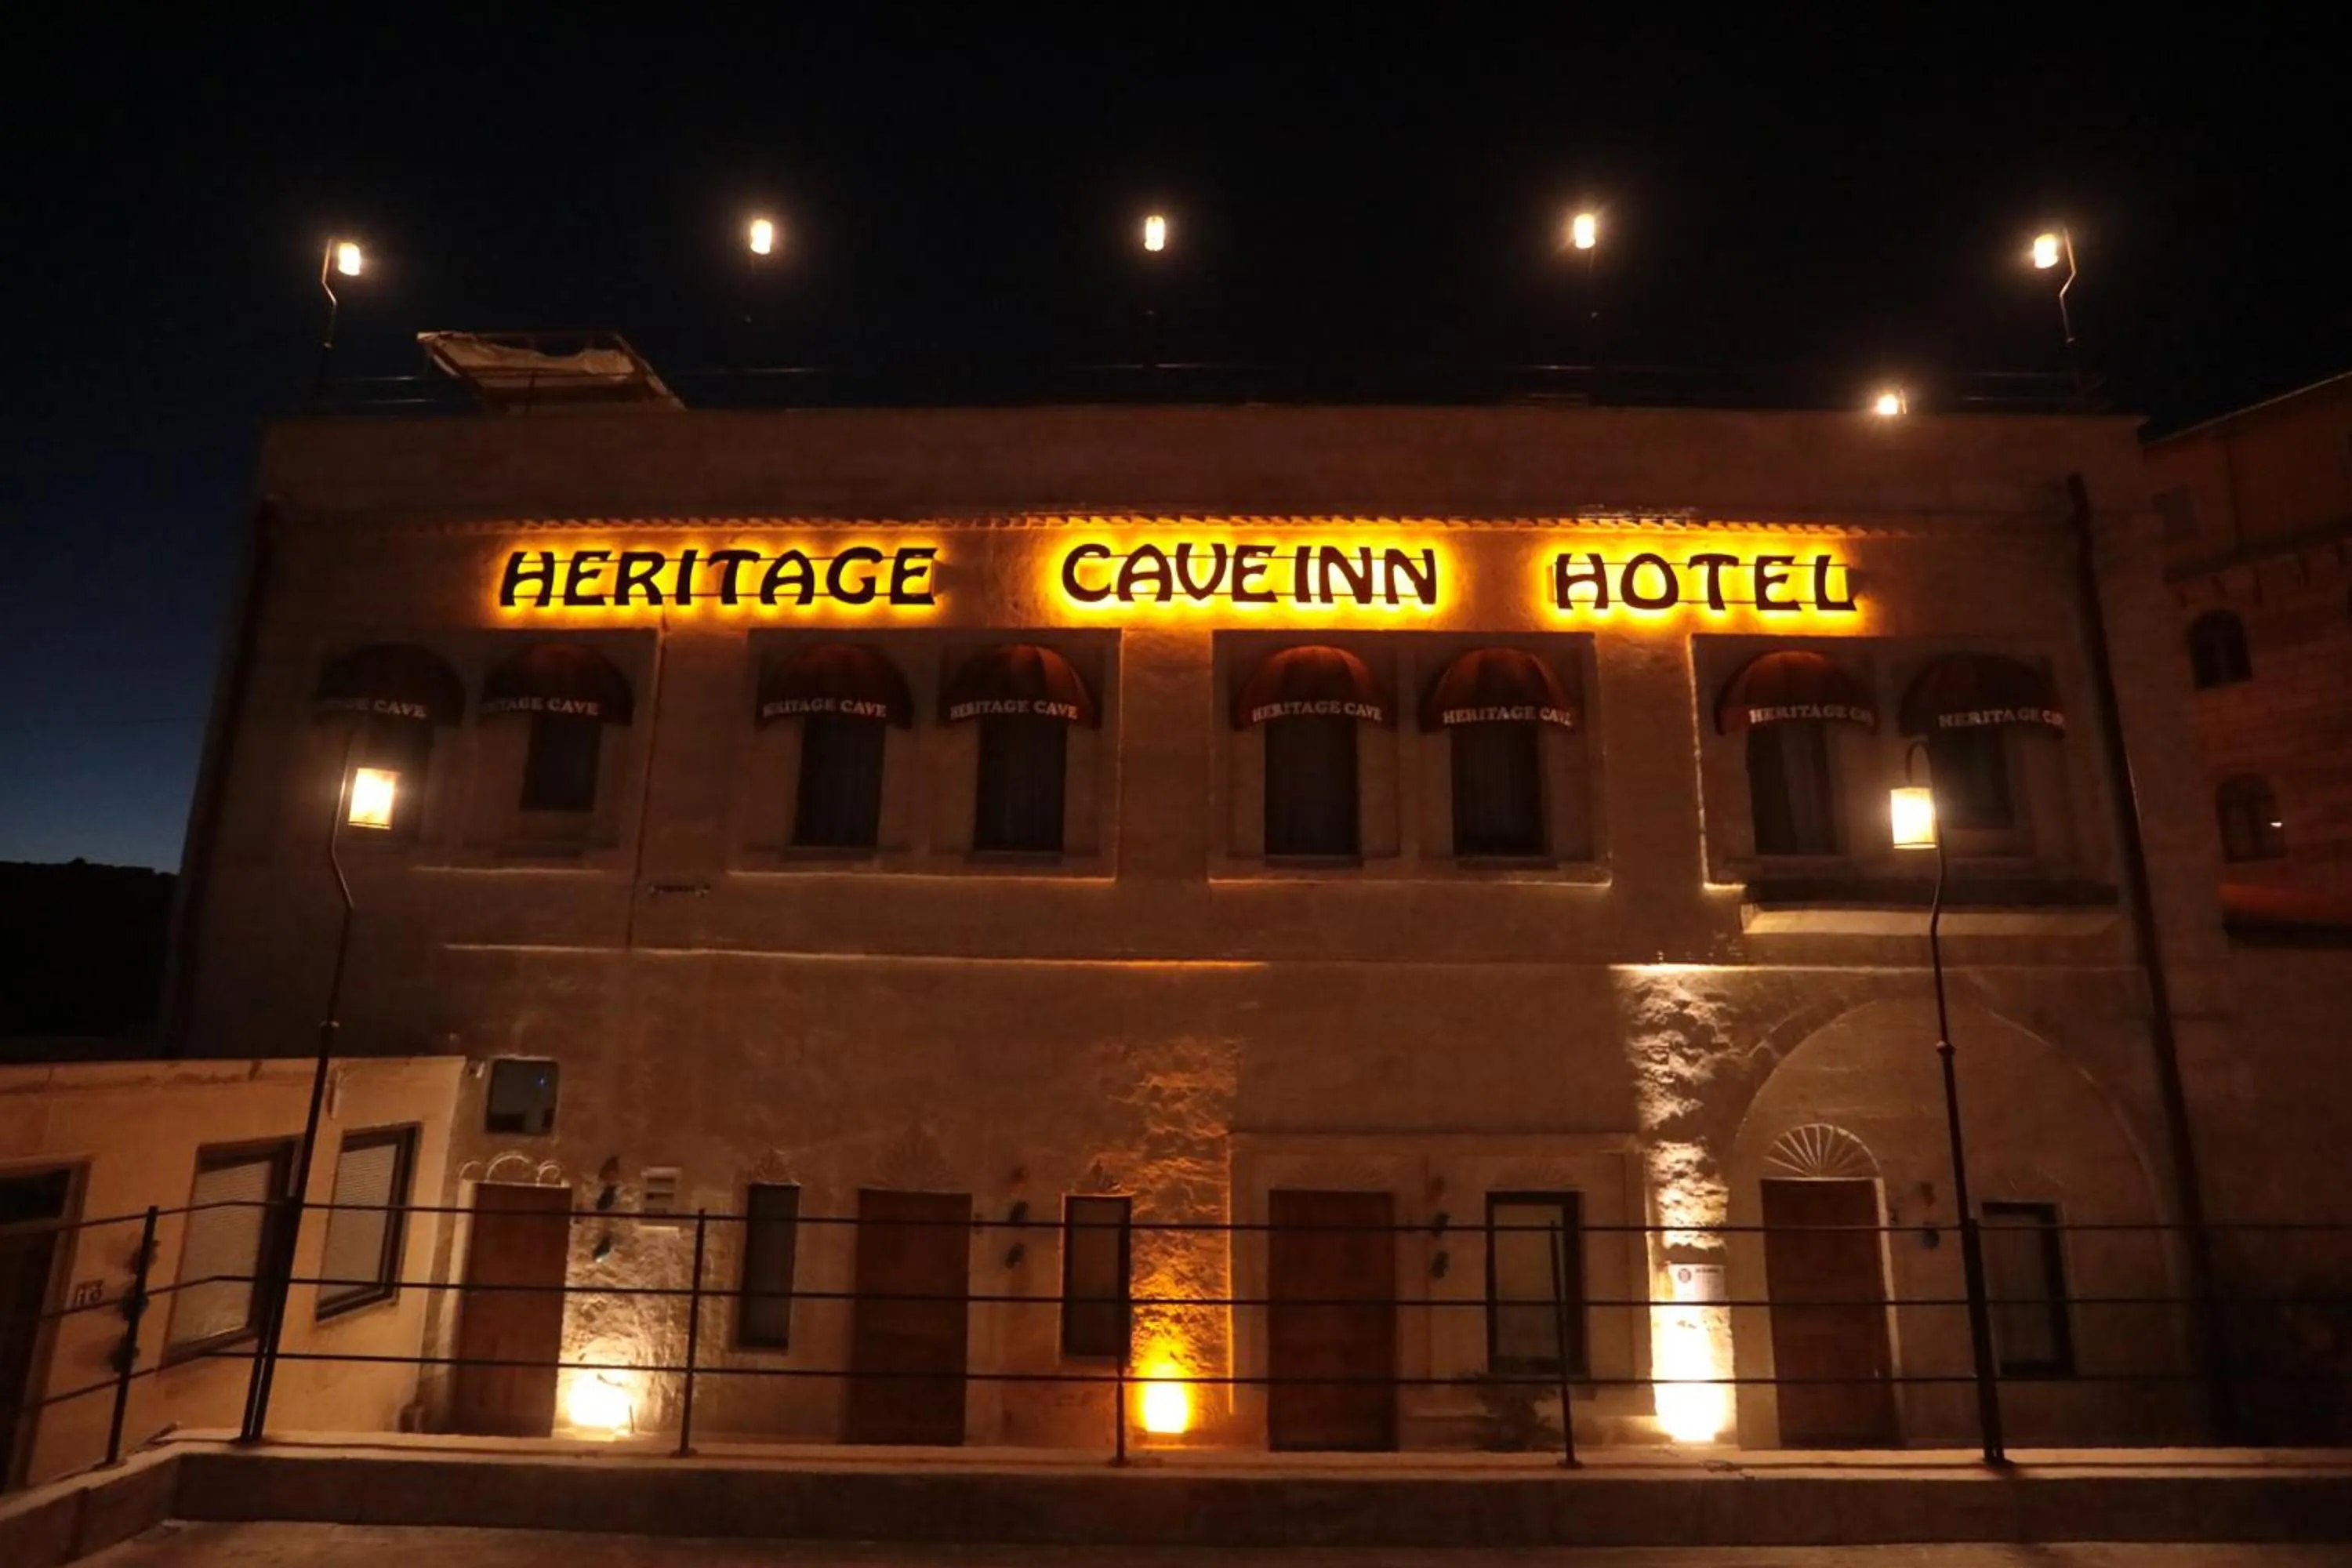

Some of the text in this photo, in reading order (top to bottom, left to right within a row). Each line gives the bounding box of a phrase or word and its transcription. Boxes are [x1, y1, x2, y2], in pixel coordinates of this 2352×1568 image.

[500, 543, 1857, 612] HERITAGE CAVE INN HOTEL
[374, 699, 427, 720] CAVE
[547, 697, 599, 716] CAVE
[840, 699, 887, 718] CAVE
[949, 699, 1078, 720] HERITAGE CAVE
[1252, 699, 1383, 723] HERITAGE CAVE
[1442, 705, 1537, 725] HERITAGE
[1748, 703, 1847, 724] HERITAGE
[1937, 706, 2041, 728] HERITAGE
